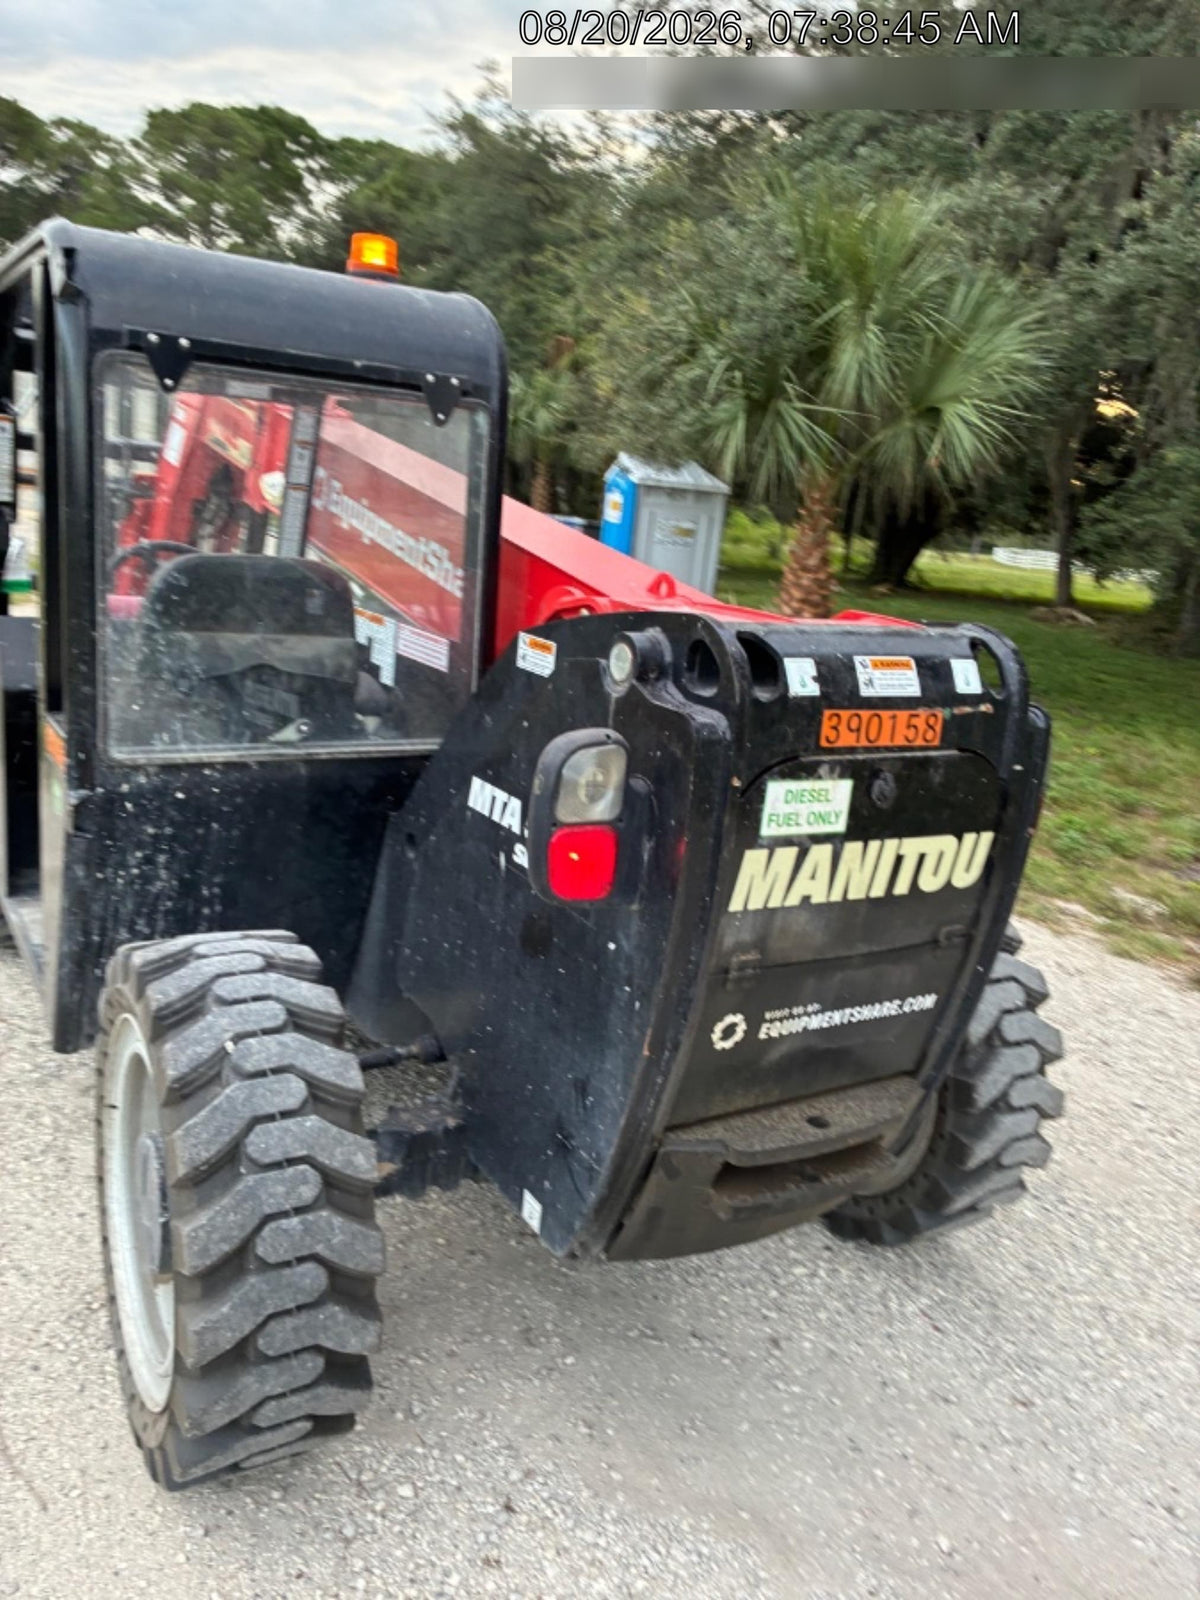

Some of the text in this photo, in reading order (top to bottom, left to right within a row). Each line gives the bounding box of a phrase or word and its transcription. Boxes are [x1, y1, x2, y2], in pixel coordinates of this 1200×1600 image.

[825, 712, 938, 744] 390158
[467, 775, 522, 836] MTA
[784, 789, 832, 805] DIESEL
[767, 809, 842, 828] FUEL ONLY
[728, 831, 995, 912] MANITOU
[758, 992, 938, 1040] EQUIPMENTSHARE.COM
